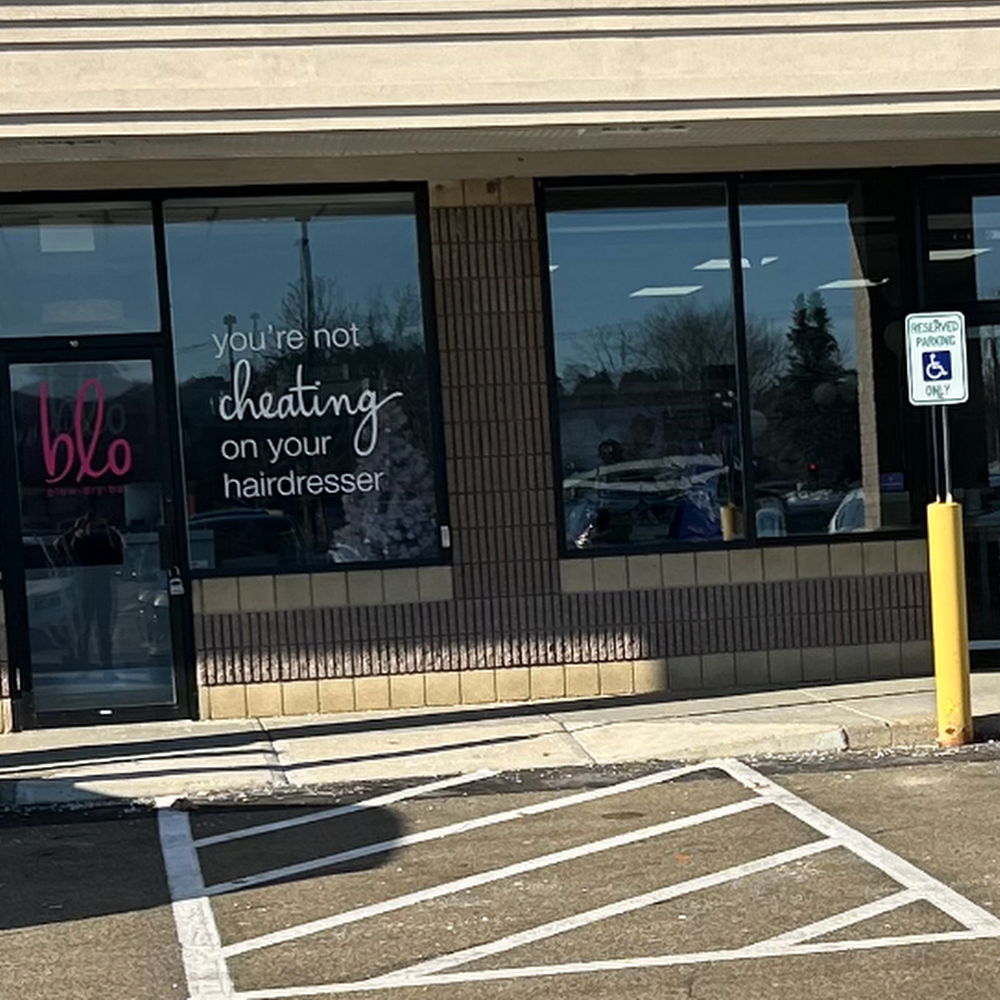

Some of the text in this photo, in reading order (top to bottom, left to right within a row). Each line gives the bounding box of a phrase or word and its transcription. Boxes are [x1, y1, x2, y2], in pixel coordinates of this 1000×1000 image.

[212, 322, 360, 359] you're not
[911, 320, 960, 333] RESERVED
[916, 335, 956, 347] PARKING
[925, 384, 951, 398] ONLY
[219, 359, 404, 456] cheating
[40, 378, 132, 484] blo
[221, 435, 332, 464] on your
[223, 470, 385, 498] hairdresser
